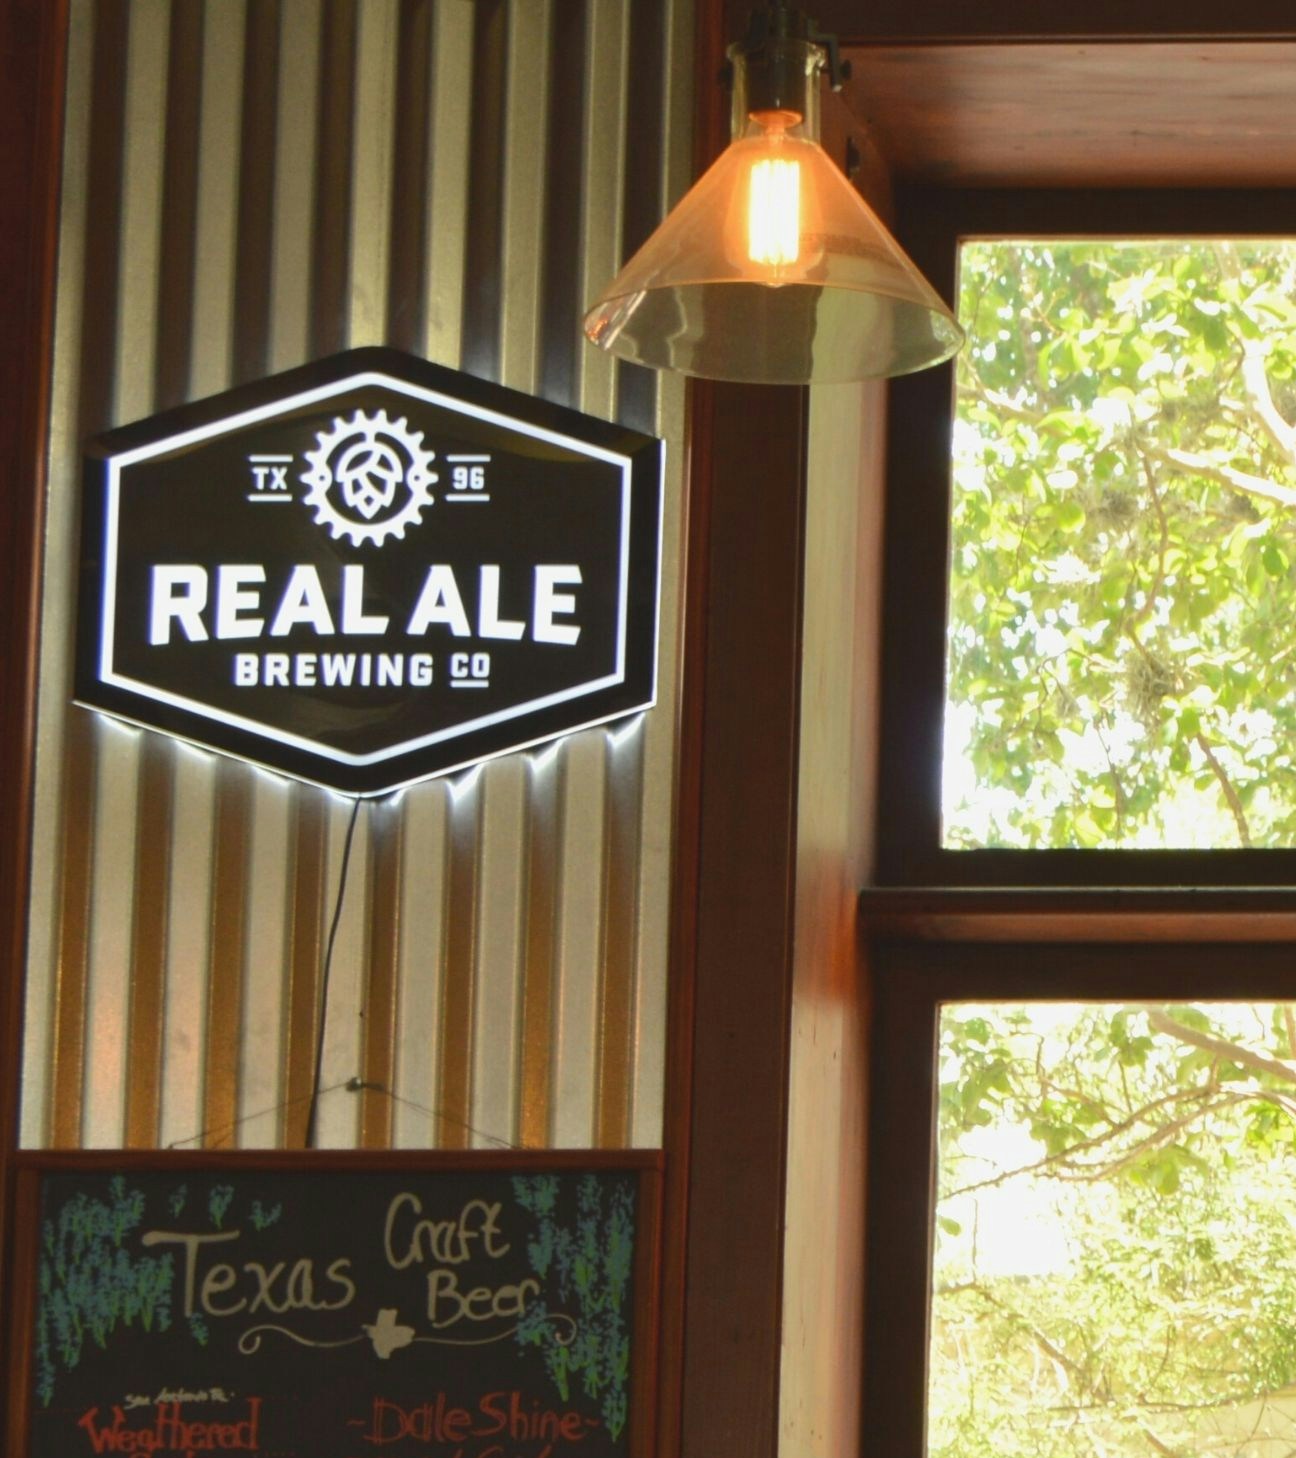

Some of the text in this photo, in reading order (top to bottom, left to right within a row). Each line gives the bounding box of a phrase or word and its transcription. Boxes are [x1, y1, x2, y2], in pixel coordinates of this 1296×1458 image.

[252, 467, 288, 491] TX
[452, 467, 485, 491] 96
[148, 564, 583, 646] REAL ALE
[234, 652, 490, 687] BREWING CO
[385, 1193, 510, 1269] Craft
[142, 1230, 355, 1318] Texas
[428, 1270, 540, 1328] Beer
[471, 1390, 587, 1441] Shine
